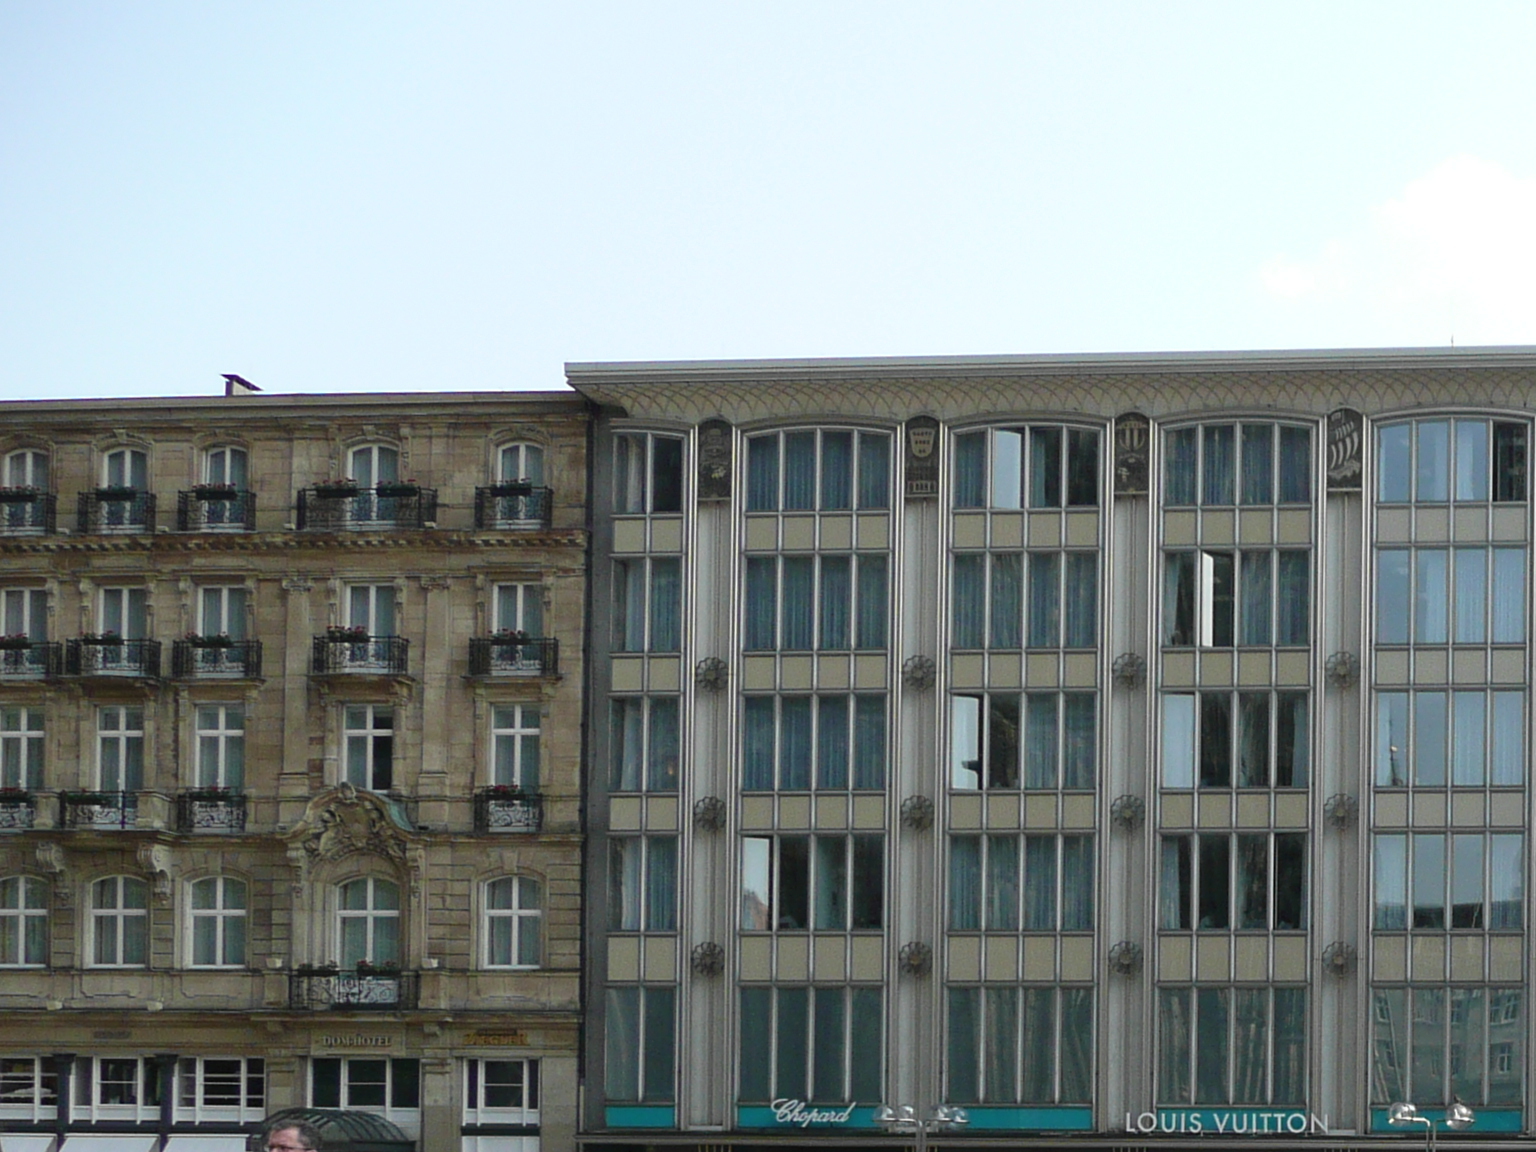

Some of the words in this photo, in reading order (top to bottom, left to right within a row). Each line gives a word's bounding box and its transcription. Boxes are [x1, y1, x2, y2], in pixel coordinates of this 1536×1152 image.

[770, 1098, 857, 1128] Chopard
[1126, 1112, 1201, 1134] LOUIS
[1213, 1112, 1329, 1134] VUITTON
